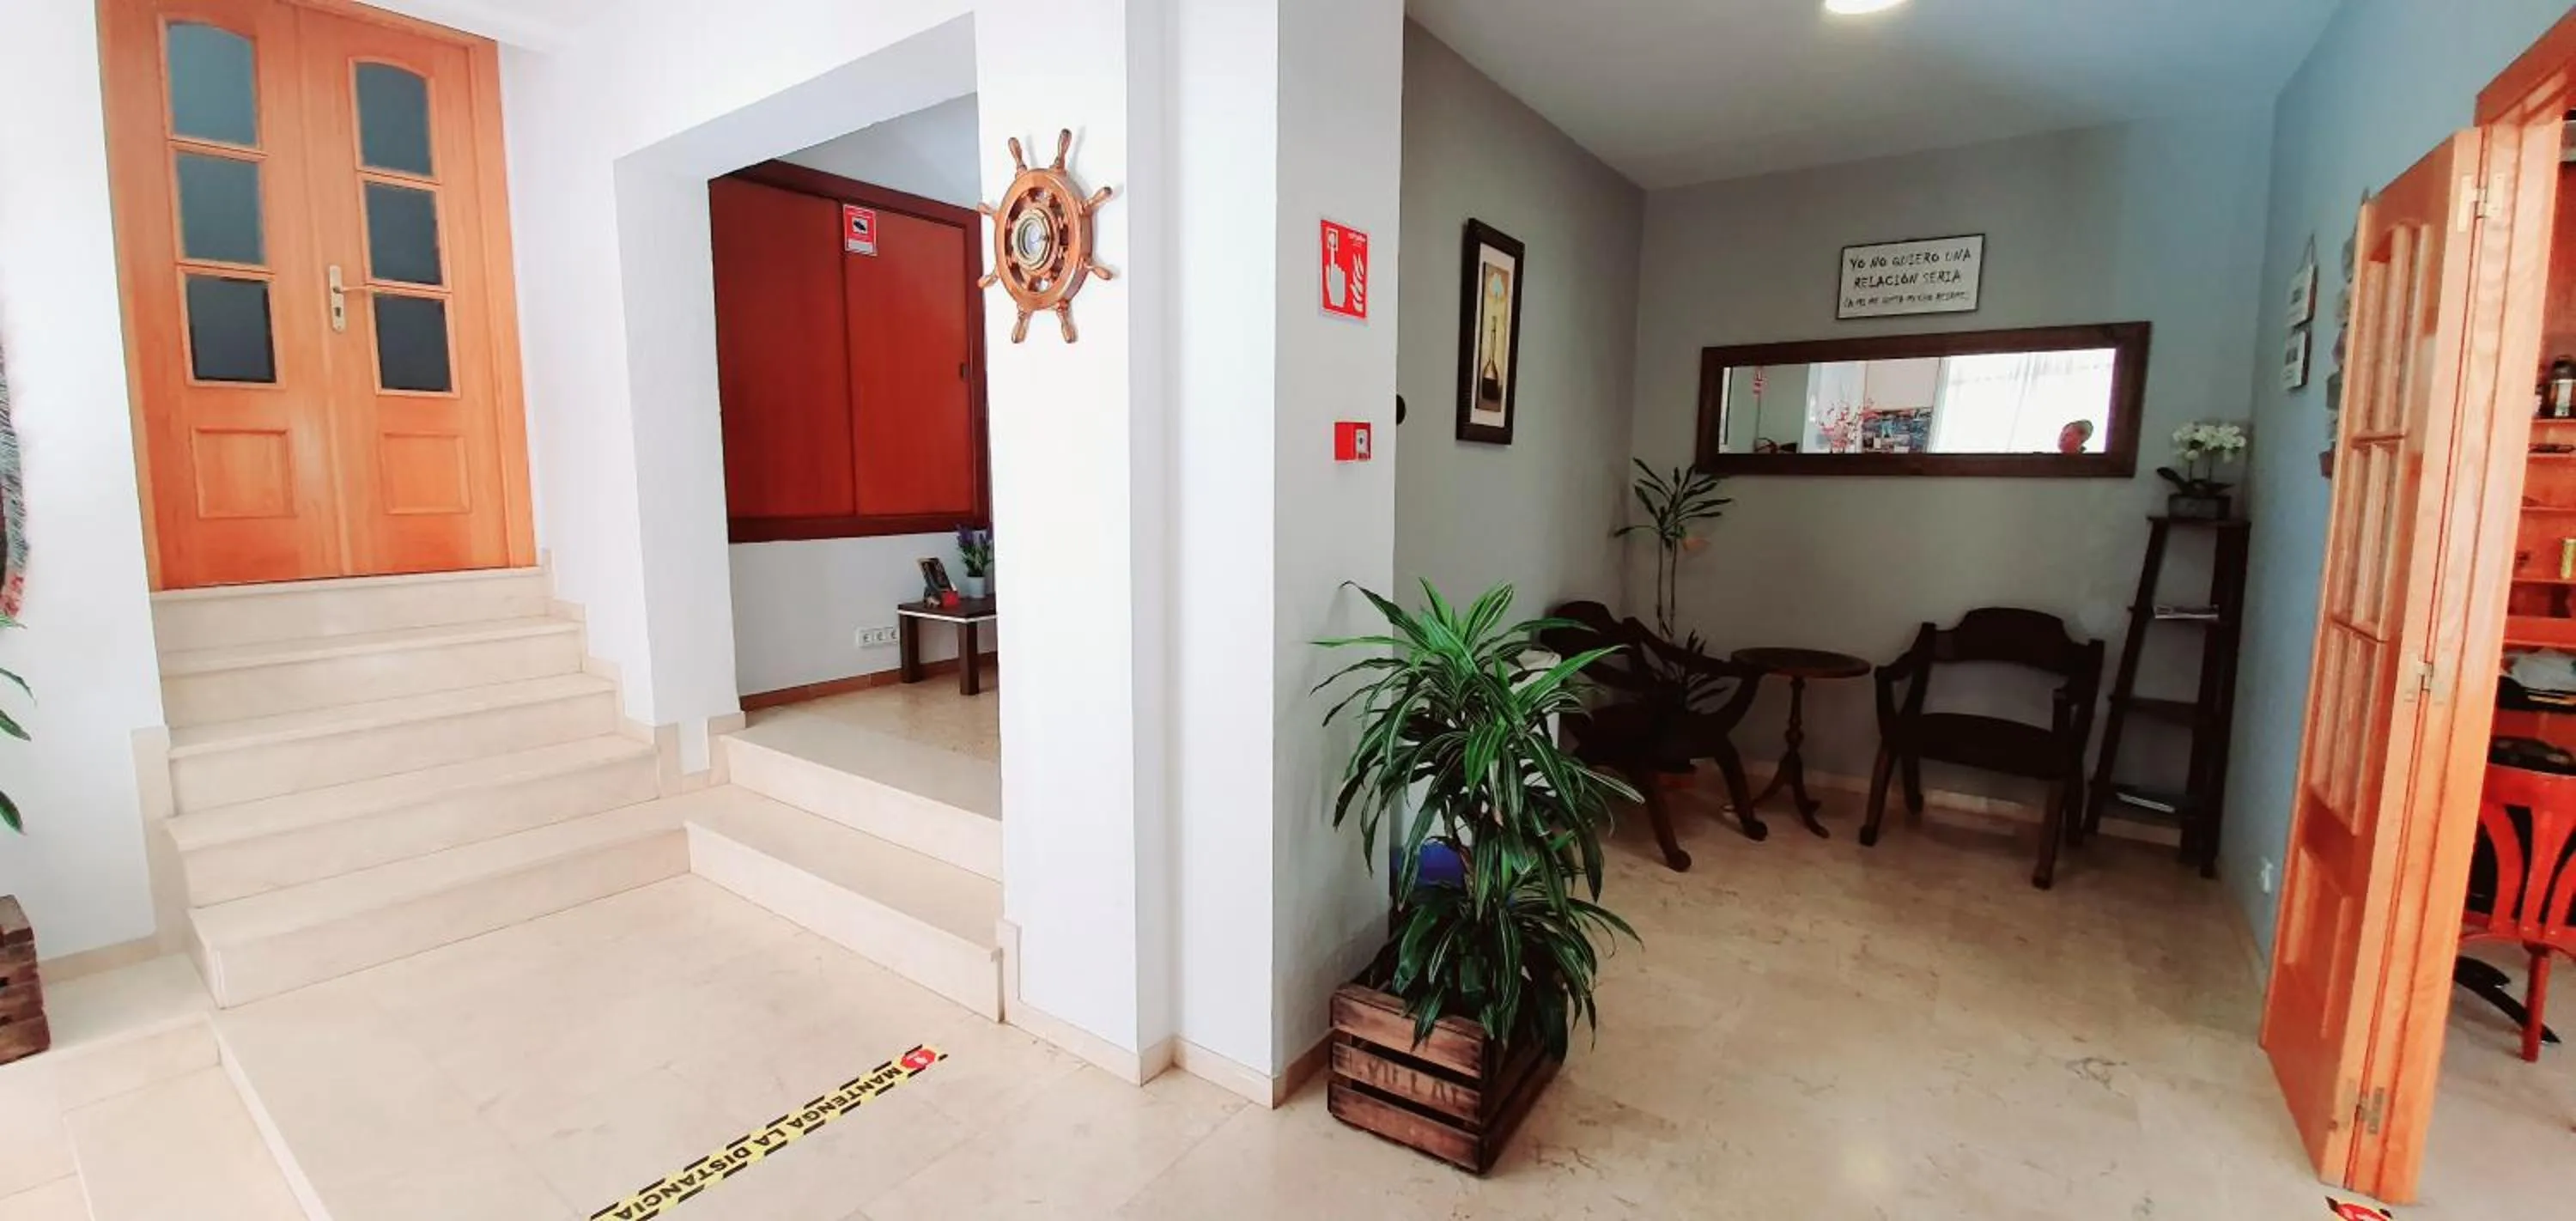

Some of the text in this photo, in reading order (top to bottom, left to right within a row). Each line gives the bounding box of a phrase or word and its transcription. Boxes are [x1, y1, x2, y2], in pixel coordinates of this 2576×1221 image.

[1849, 257, 1867, 270] YO
[1870, 255, 1888, 269] NO
[1892, 251, 1941, 267] QUIERO
[1923, 269, 1962, 285] SERIA
[613, 1066, 902, 1220] MANTENGA LA DISTANCIA
